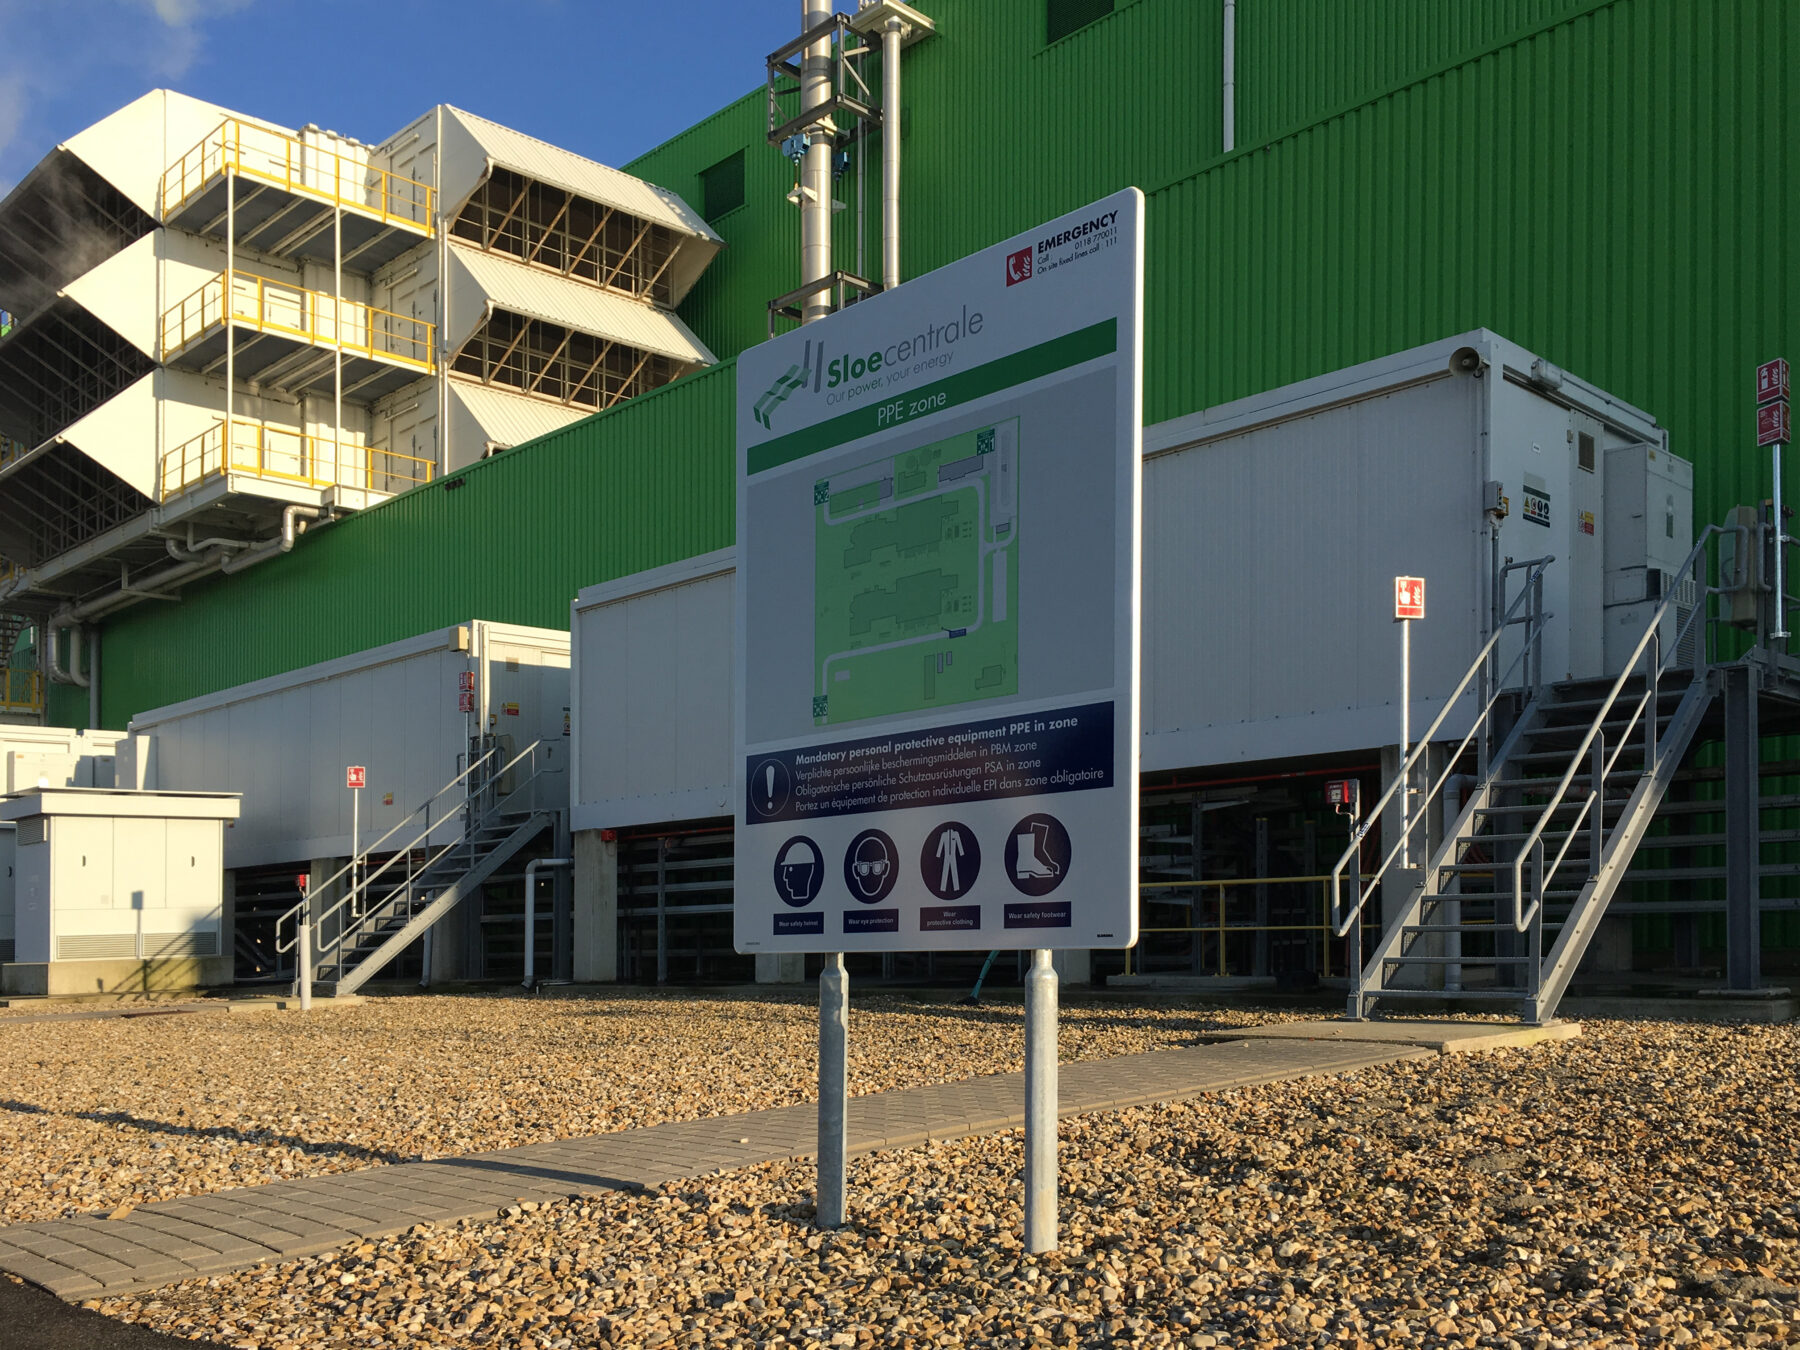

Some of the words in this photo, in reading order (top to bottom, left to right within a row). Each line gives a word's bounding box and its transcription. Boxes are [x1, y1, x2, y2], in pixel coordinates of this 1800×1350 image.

[1038, 210, 1118, 254] EMERGENCY
[1038, 254, 1049, 265] Call
[1075, 237, 1092, 250] 0118
[1093, 227, 1117, 243] 770011
[1038, 266, 1047, 275] On
[1048, 262, 1058, 271] site
[1059, 254, 1073, 266] fixed
[1075, 249, 1088, 260] lines
[1089, 243, 1100, 254] call
[1106, 237, 1117, 247] 111
[827, 305, 984, 388] Sloecentrale
[826, 391, 846, 406] Our
[847, 377, 884, 400] power,
[886, 367, 910, 389] your
[913, 350, 954, 372] energy
[878, 400, 904, 427] PPE
[909, 392, 947, 417] zone
[795, 751, 847, 766] Mandatory
[850, 741, 892, 760] personal
[894, 734, 945, 754] protective
[948, 726, 1007, 745] equipment
[1009, 721, 1031, 735] PPE
[1034, 720, 1045, 732] in
[1049, 716, 1078, 730] zone
[795, 766, 832, 782] Verplichte
[834, 760, 880, 779] persoonlijke
[882, 746, 977, 769] beschermingsmiddelen
[980, 745, 988, 757] in
[990, 742, 1011, 756] PBM
[1014, 741, 1037, 753] zone
[795, 779, 850, 797] Obligatorische
[851, 774, 897, 793] persönliche
[899, 765, 982, 785] Schutzausrüstungen
[984, 761, 1003, 774] PSA
[1006, 759, 1015, 771] in
[1018, 758, 1041, 770] zone
[795, 800, 818, 811] Portez
[821, 801, 830, 809] un
[831, 793, 876, 811] équipement
[877, 791, 888, 803] de
[890, 788, 931, 805] protection
[932, 780, 981, 797] individuelle
[983, 778, 997, 791] EPI
[999, 777, 1022, 789] dans
[1024, 775, 1048, 787] zone
[1050, 768, 1104, 786] obligatoire
[952, 918, 973, 926] clothing
[1008, 912, 1023, 920] Wear
[1023, 911, 1041, 920] safety
[1041, 911, 1067, 919] footwear
